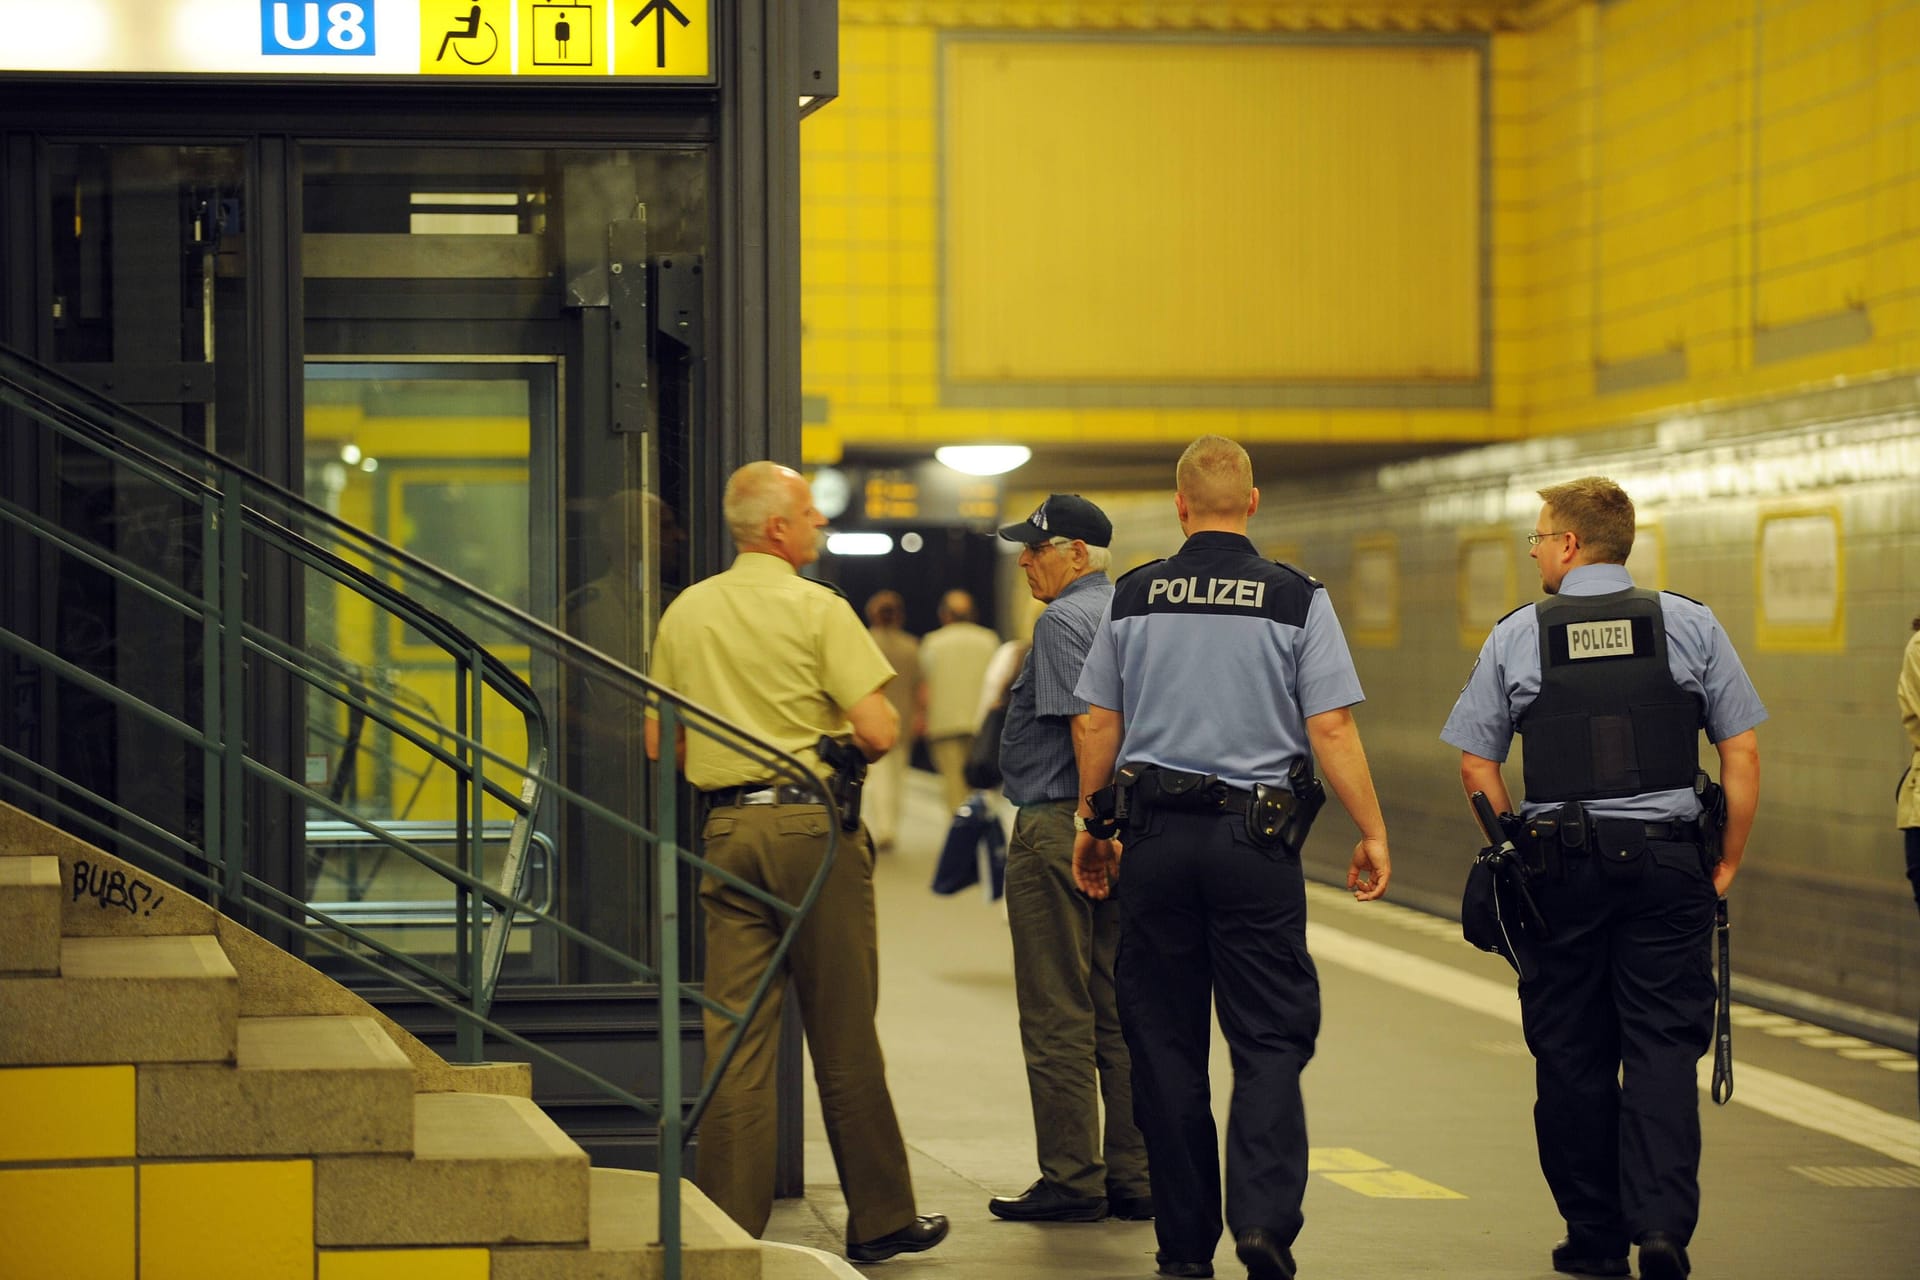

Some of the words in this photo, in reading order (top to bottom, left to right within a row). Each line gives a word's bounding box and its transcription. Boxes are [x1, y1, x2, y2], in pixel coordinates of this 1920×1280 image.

[273, 2, 366, 50] U8
[1147, 576, 1265, 608] POLIZEI
[1572, 626, 1628, 652] POLIZEI
